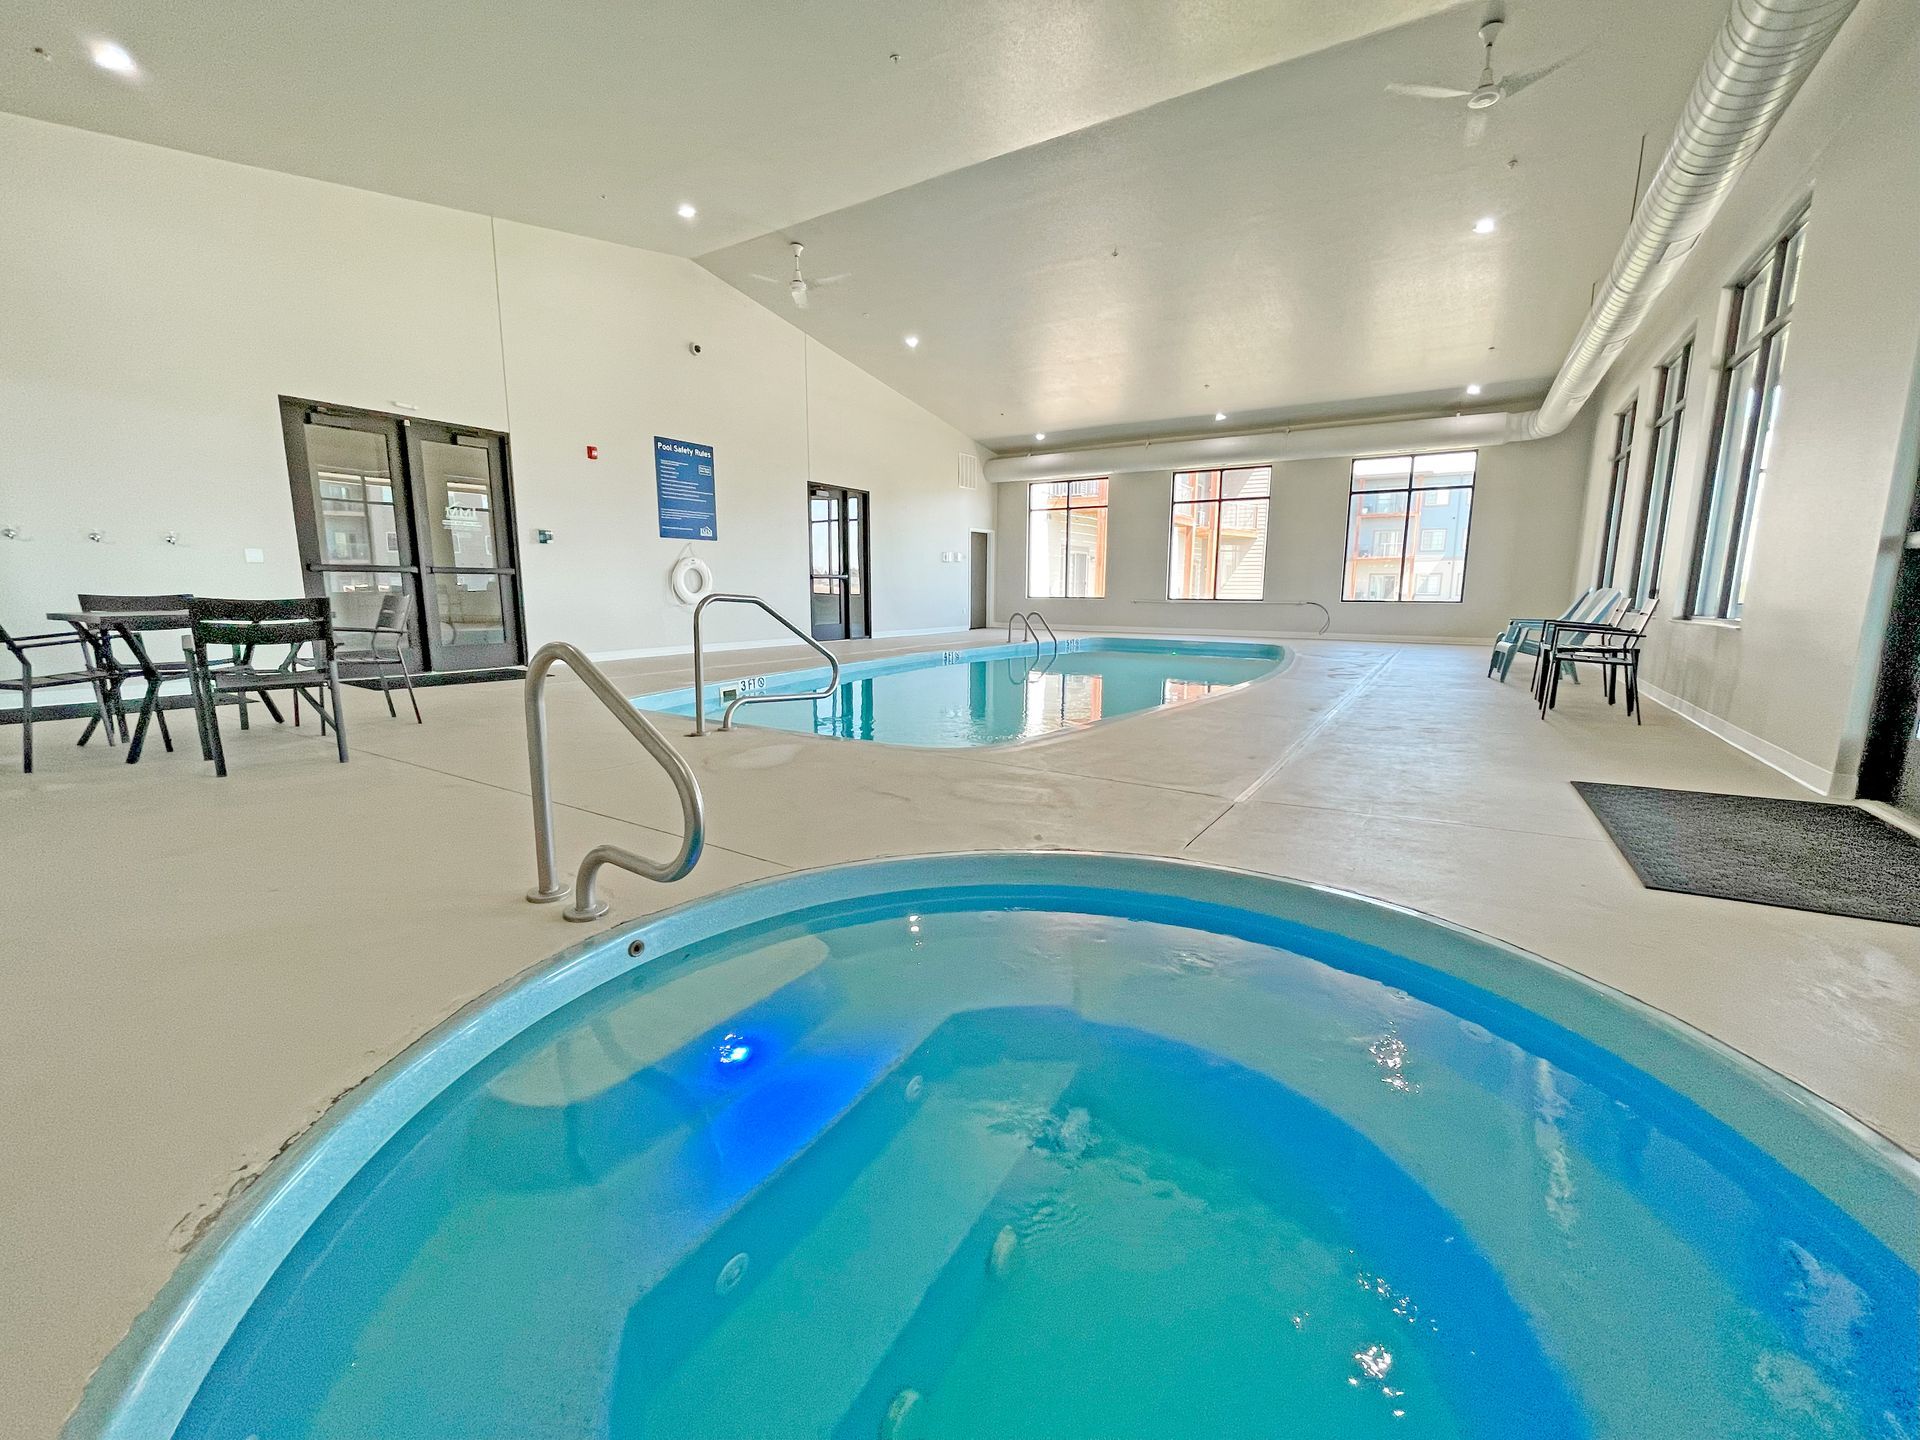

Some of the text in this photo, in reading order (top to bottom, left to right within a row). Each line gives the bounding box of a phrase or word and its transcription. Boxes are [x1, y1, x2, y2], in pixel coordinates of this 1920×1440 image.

[657, 441, 711, 458] Pool Safety Rules
[740, 680, 746, 691] 3
